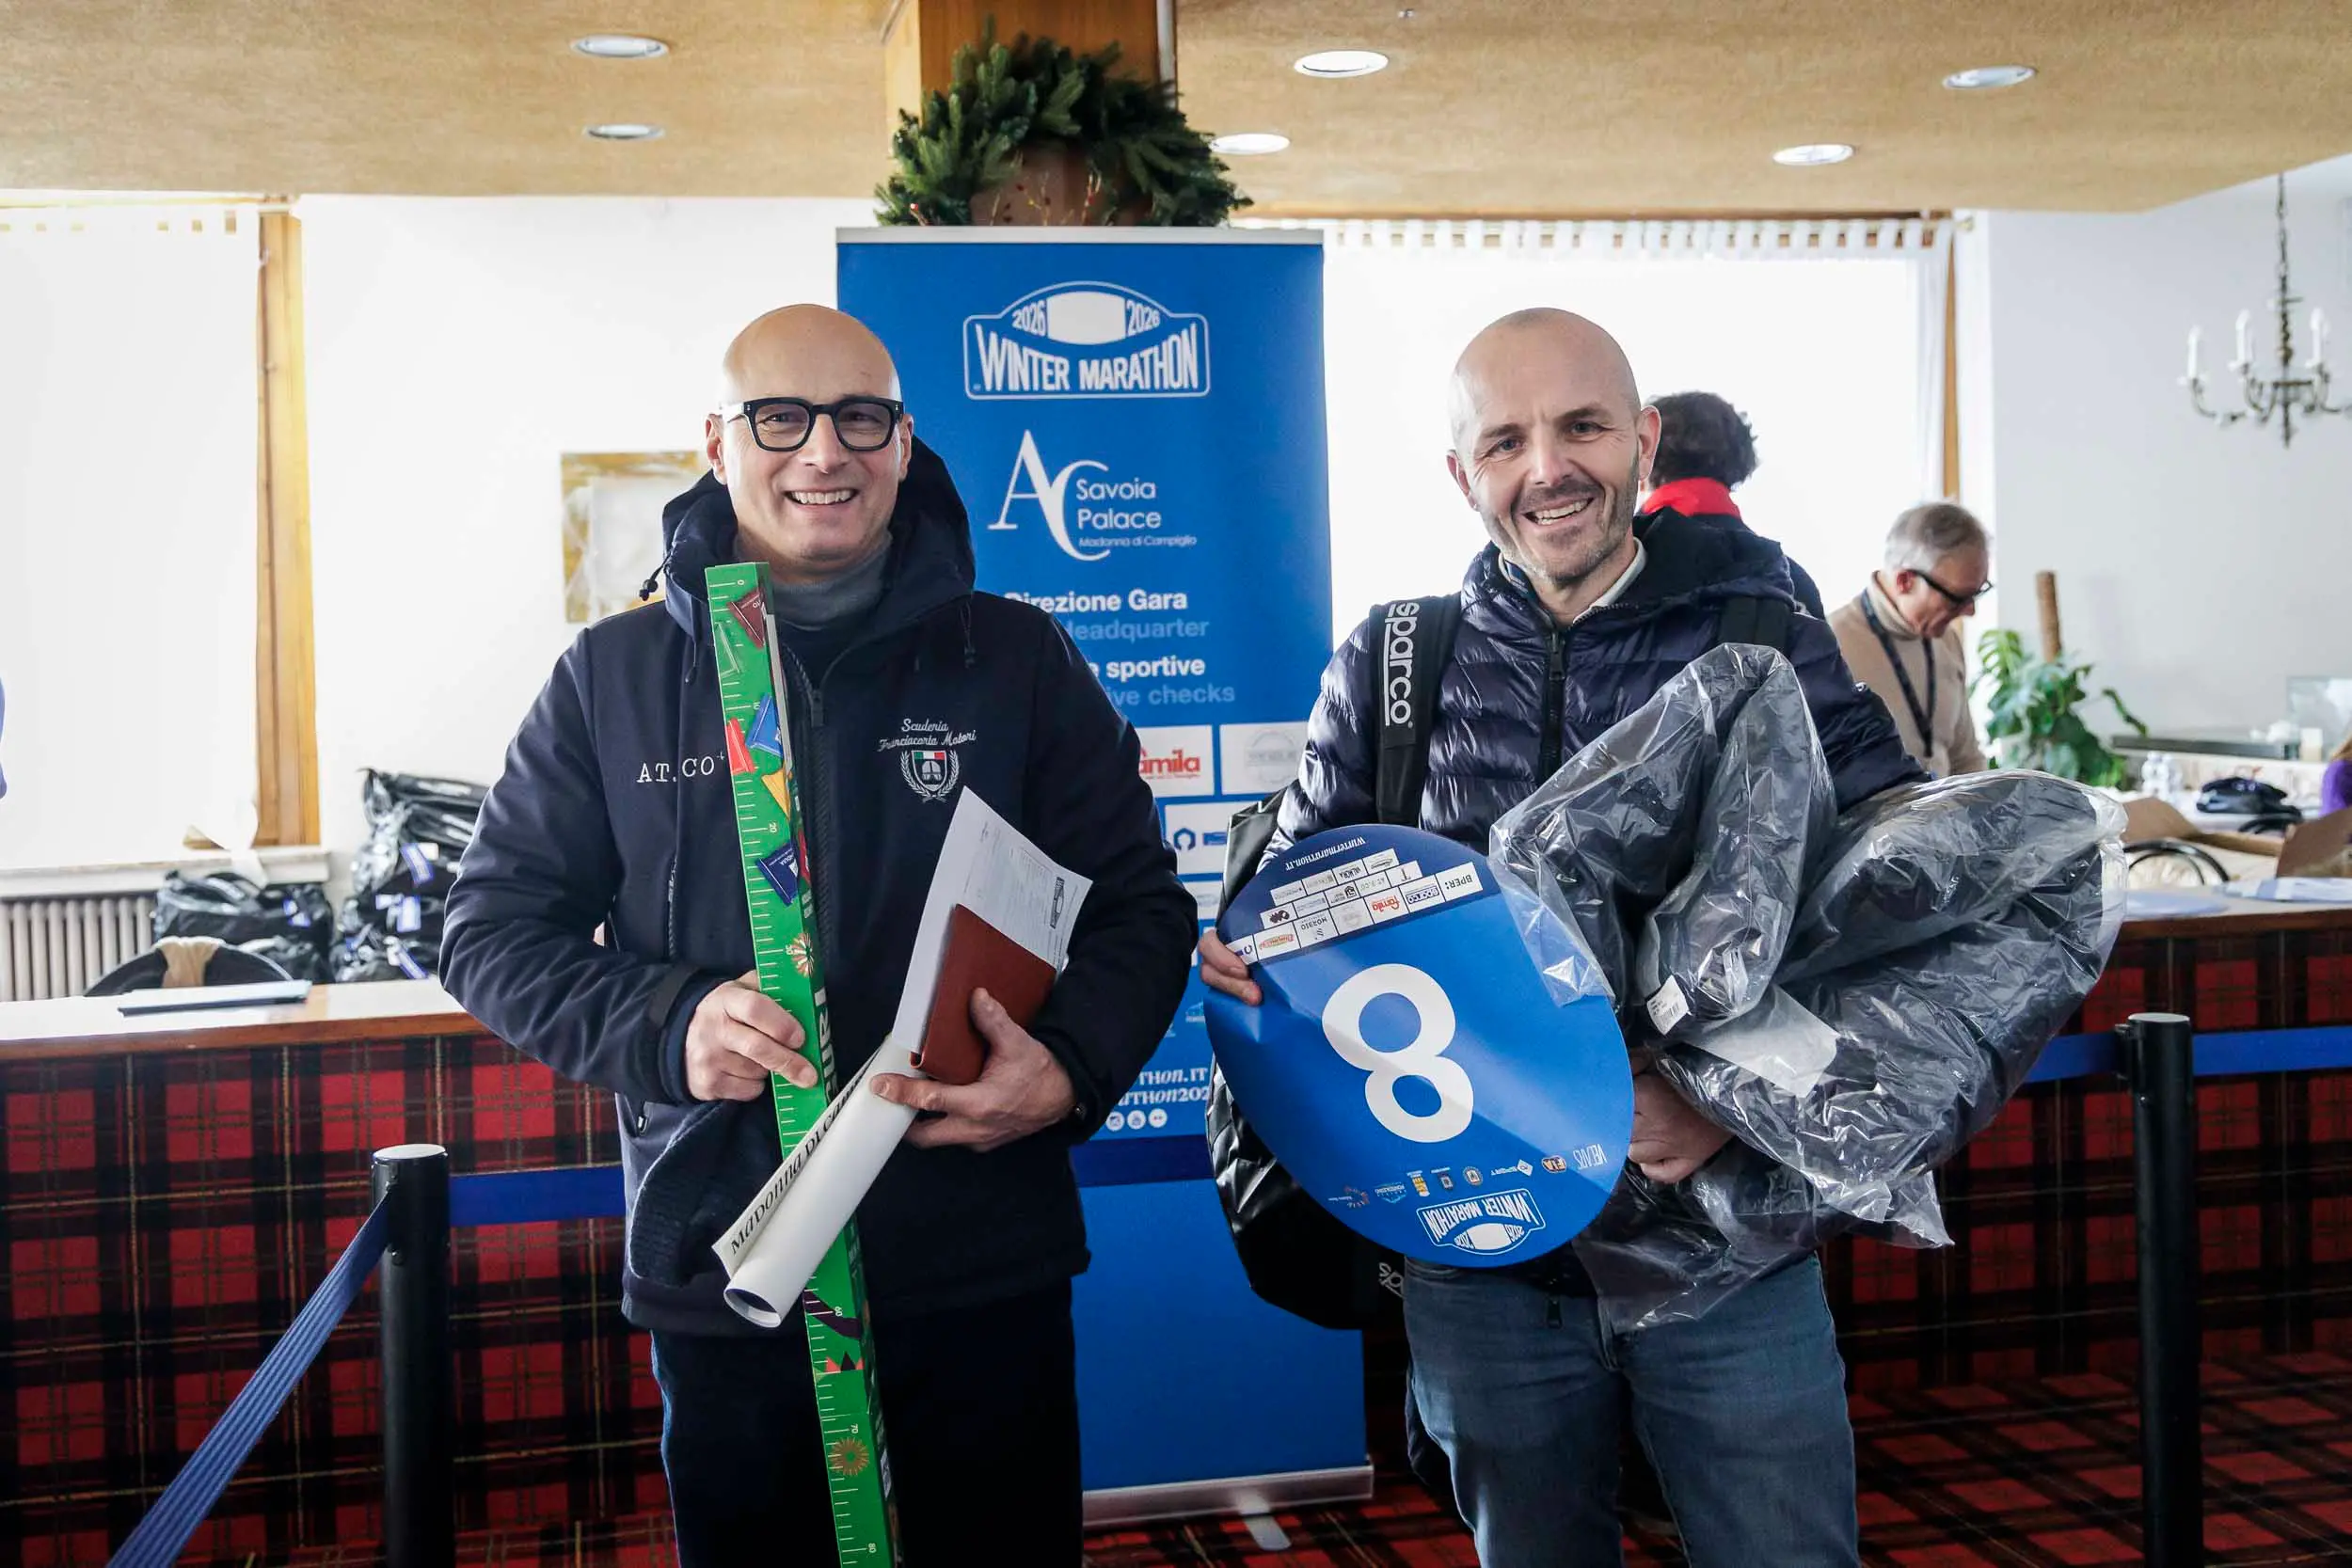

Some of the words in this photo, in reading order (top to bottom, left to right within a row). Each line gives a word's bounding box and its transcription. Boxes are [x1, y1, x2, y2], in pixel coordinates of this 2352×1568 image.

[1011, 299, 1047, 337] 2026
[1126, 299, 1161, 338] 2026
[976, 323, 1071, 391] WINTER
[1078, 322, 1200, 391] MARATHON
[1075, 477, 1157, 500] Savoia
[1076, 508, 1162, 531] Palace
[1079, 536, 1131, 547] Madonna
[1128, 588, 1189, 610] Gara
[1105, 655, 1206, 683] sportive
[1385, 602, 1420, 724] sparco
[1148, 683, 1236, 705] checks
[900, 718, 949, 732] Scuderia
[941, 729, 977, 747] Motori
[1321, 963, 1474, 1143] 8
[1422, 1200, 1484, 1243] MARATHON
[1481, 1192, 1540, 1227] WINTER
